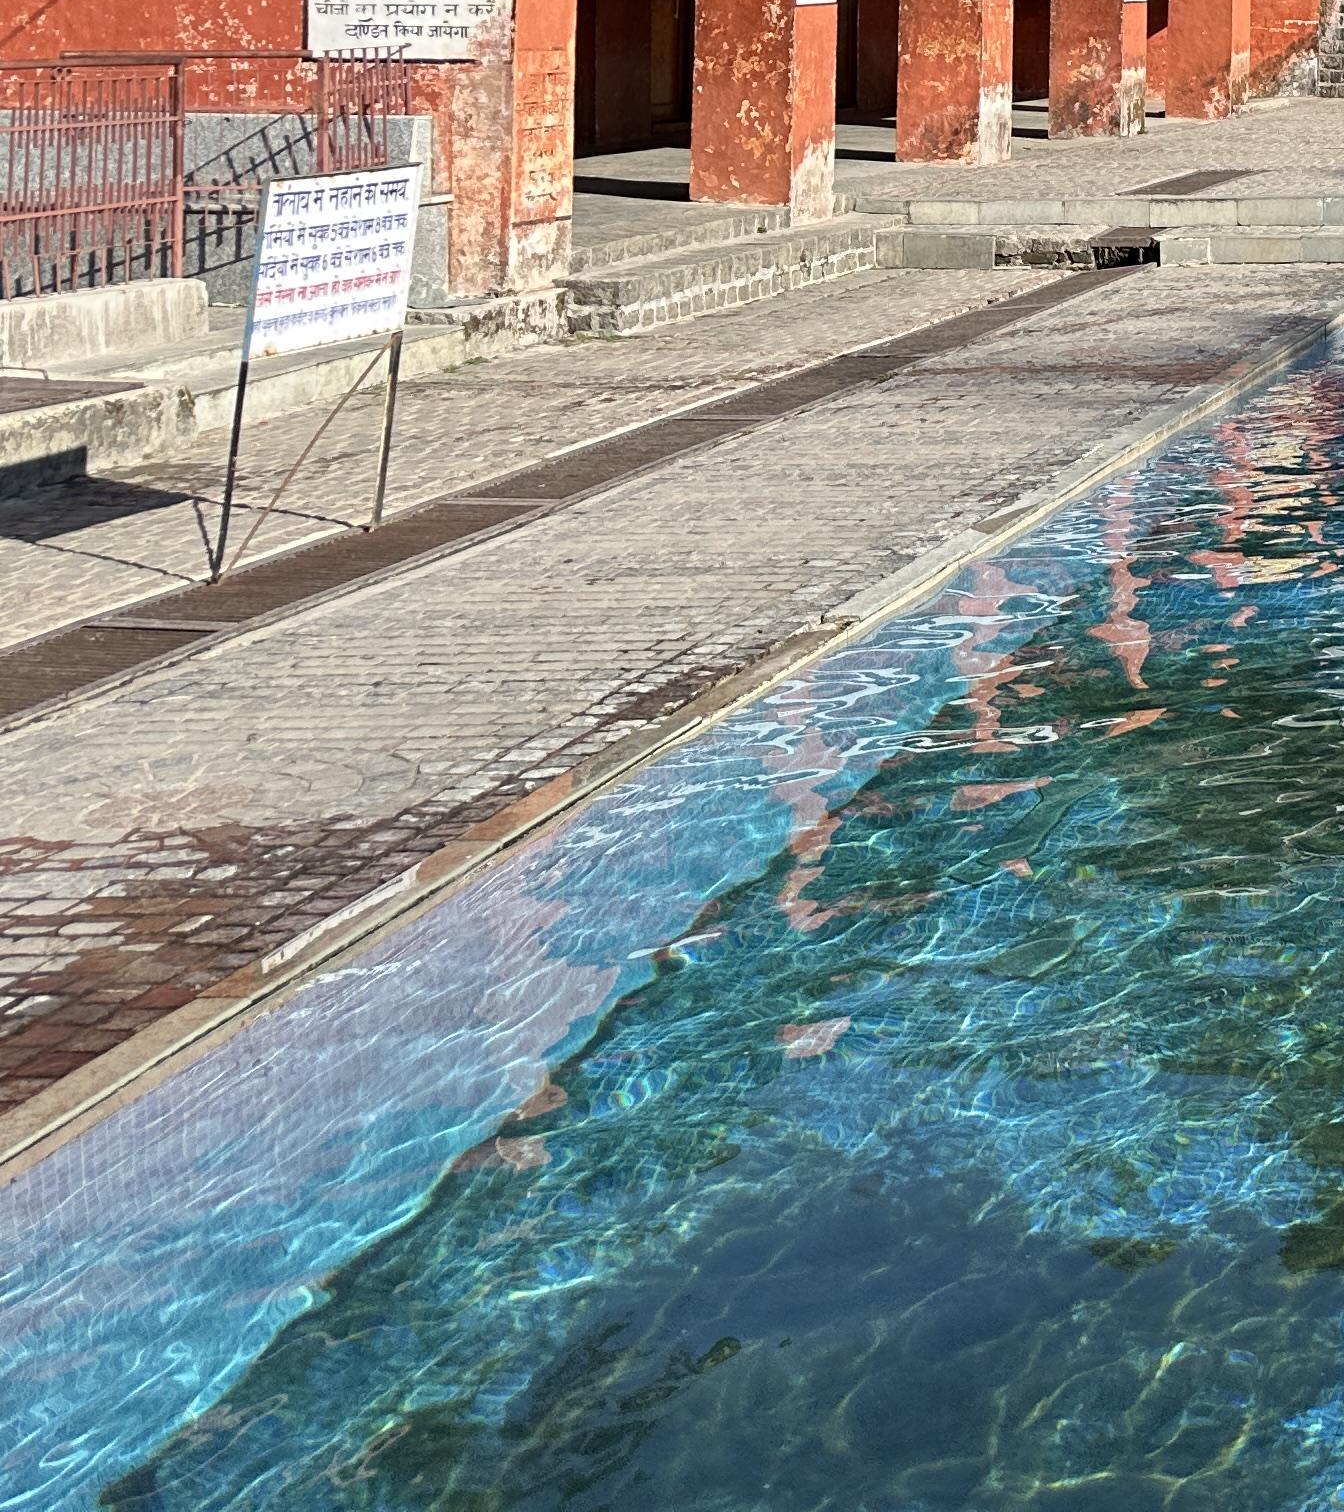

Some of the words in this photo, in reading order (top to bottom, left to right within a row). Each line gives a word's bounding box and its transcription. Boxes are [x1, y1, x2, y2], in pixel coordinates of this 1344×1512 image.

[384, 0, 437, 16] प्रयोग
[443, 4, 459, 16] न
[393, 20, 424, 36] किया
